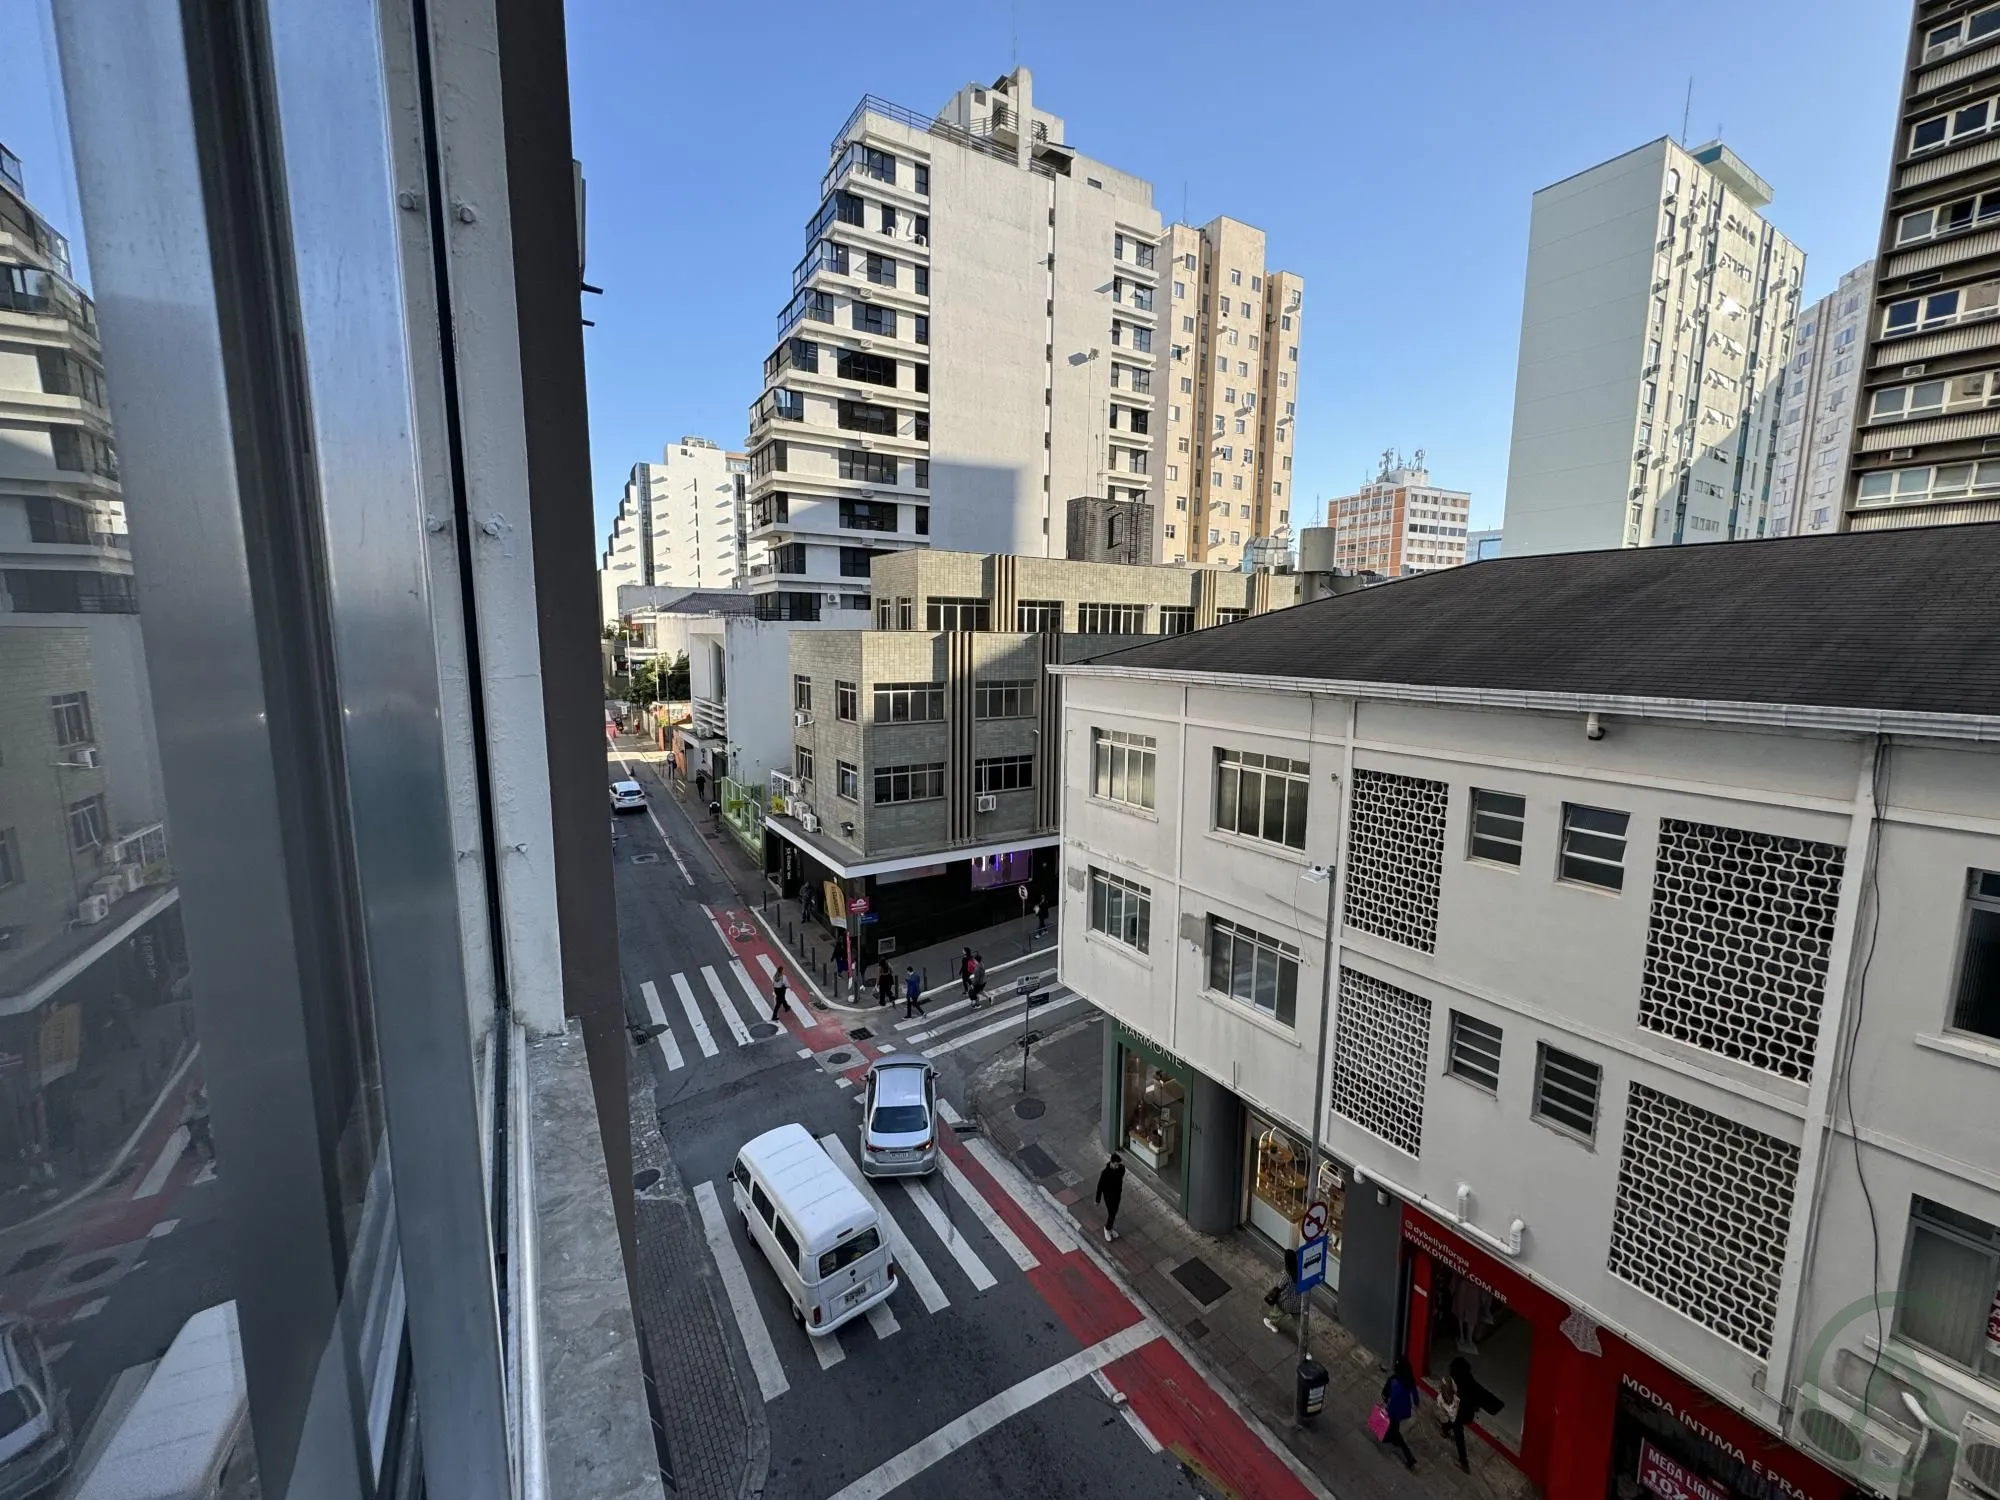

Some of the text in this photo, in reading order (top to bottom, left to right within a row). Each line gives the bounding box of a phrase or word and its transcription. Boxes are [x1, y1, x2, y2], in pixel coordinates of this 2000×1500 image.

[1119, 1021, 1184, 1070] HARMONIE
[1404, 1229, 1508, 1304] WWW.DYBELLY.COM.BR
[1622, 1373, 1815, 1500] MODA ÍNTIMA E PRA
[1648, 1448, 1683, 1483] MEGA
